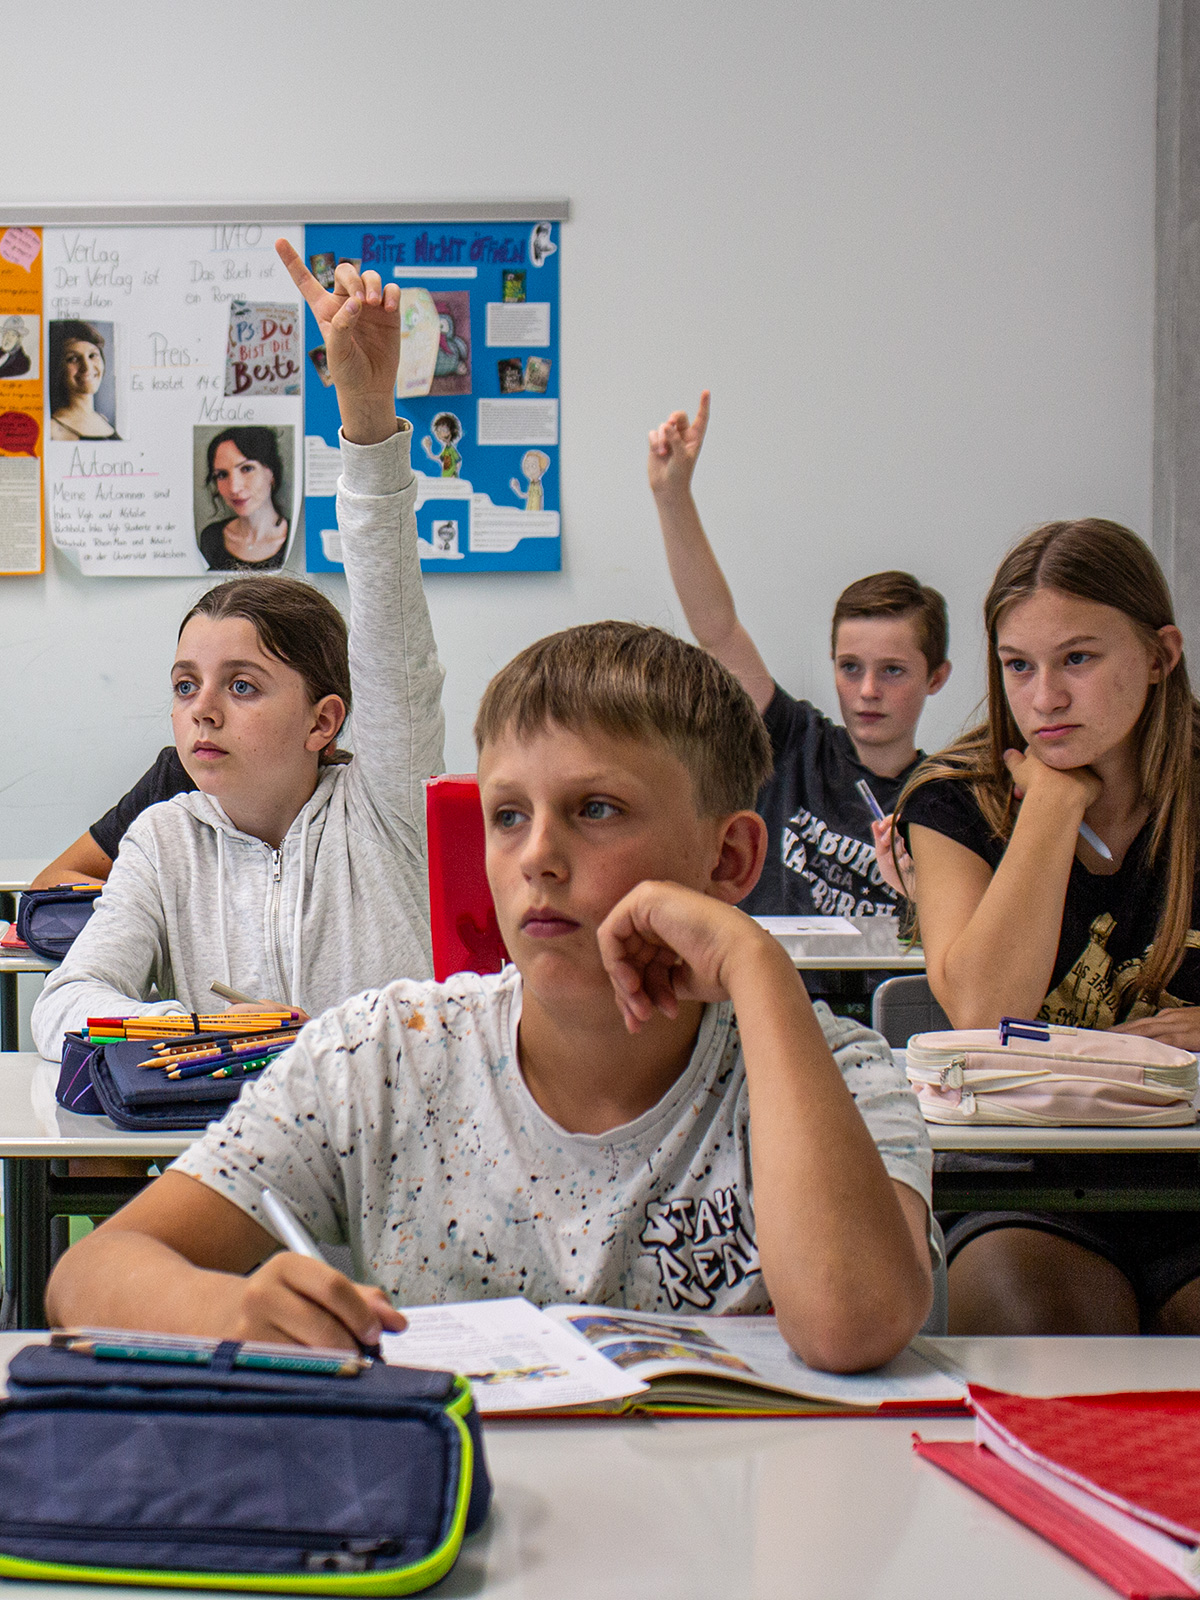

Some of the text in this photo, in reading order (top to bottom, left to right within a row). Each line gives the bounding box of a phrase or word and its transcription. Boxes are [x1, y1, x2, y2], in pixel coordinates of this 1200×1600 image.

[62, 233, 120, 268] Verlag
[213, 223, 262, 251] INFO
[414, 231, 468, 263] NICHT
[52, 264, 160, 295] Der Verlag ist
[188, 259, 216, 281] Das
[221, 258, 252, 280] Buch
[131, 374, 145, 391] Es
[197, 395, 255, 423] Natalie
[53, 481, 87, 500] Meine
[639, 1186, 742, 1253] STAY
